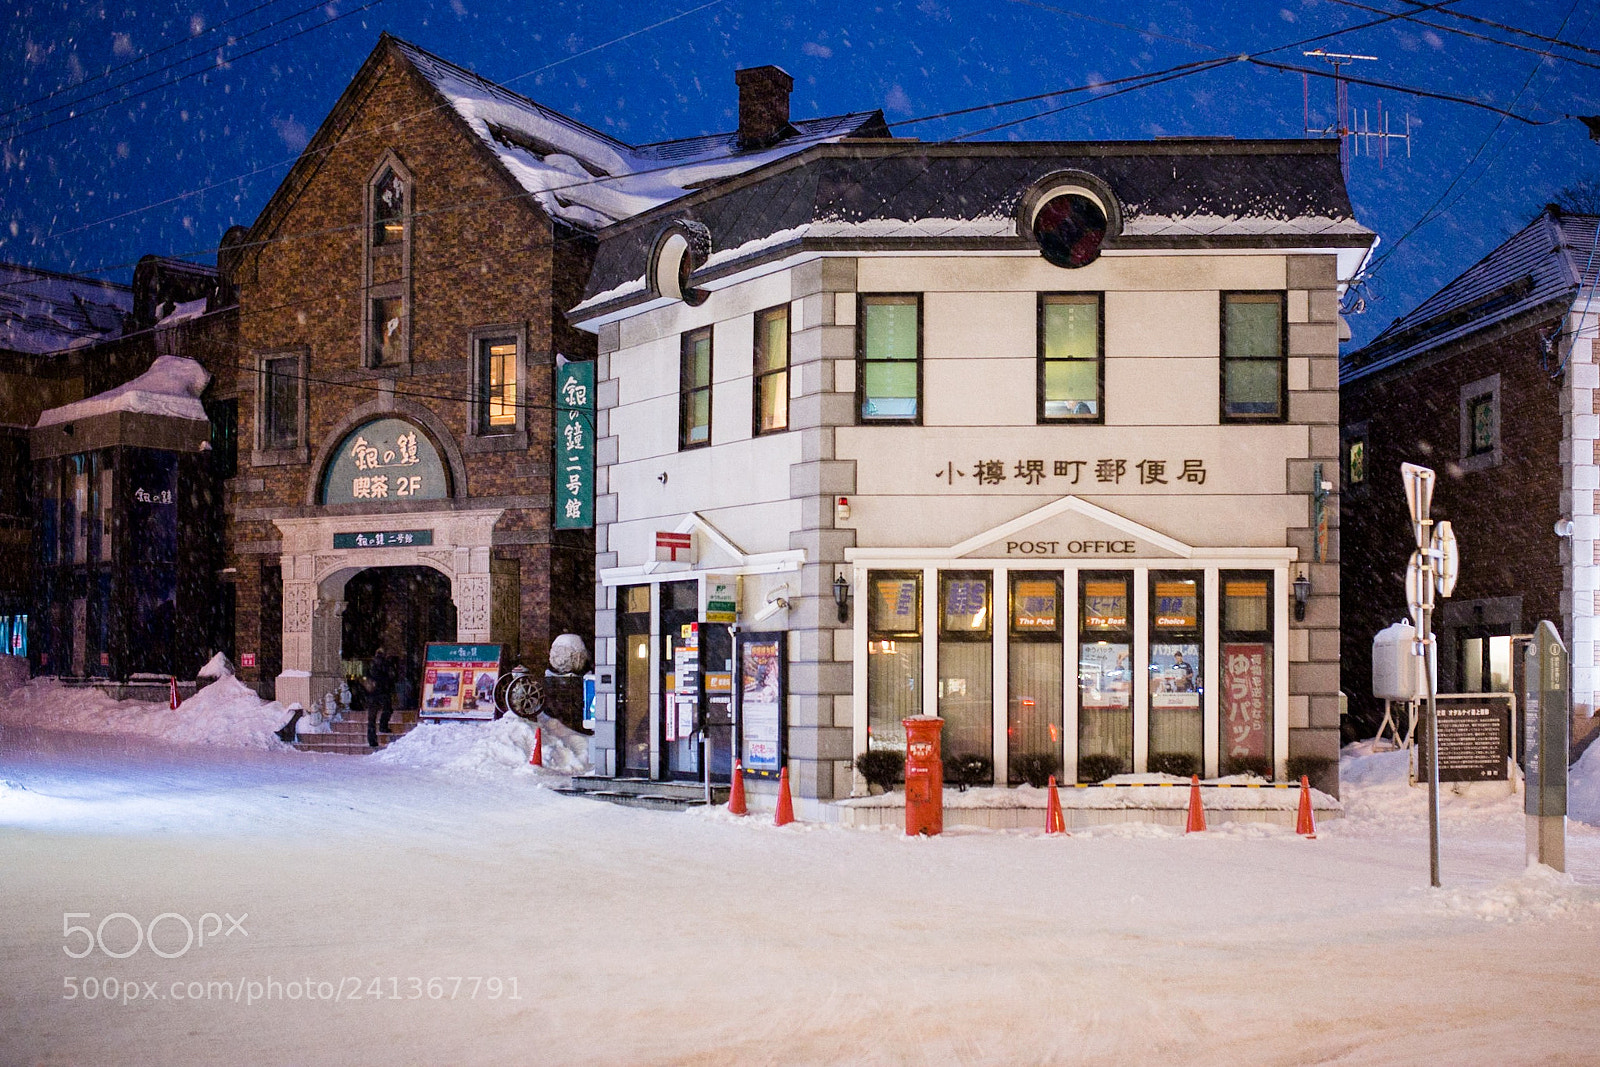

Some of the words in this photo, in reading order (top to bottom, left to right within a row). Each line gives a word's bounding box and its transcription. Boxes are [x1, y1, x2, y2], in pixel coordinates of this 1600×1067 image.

[351, 431, 420, 470] 銀の鐘
[562, 376, 587, 519] 銀の鐘二号館
[935, 459, 1207, 486] 小樽堺町郵便局
[353, 475, 388, 498] 喫茶
[396, 476, 422, 496] 2F
[1006, 541, 1059, 554] POST
[1067, 541, 1136, 554] OFFICE
[1037, 618, 1055, 626] Post
